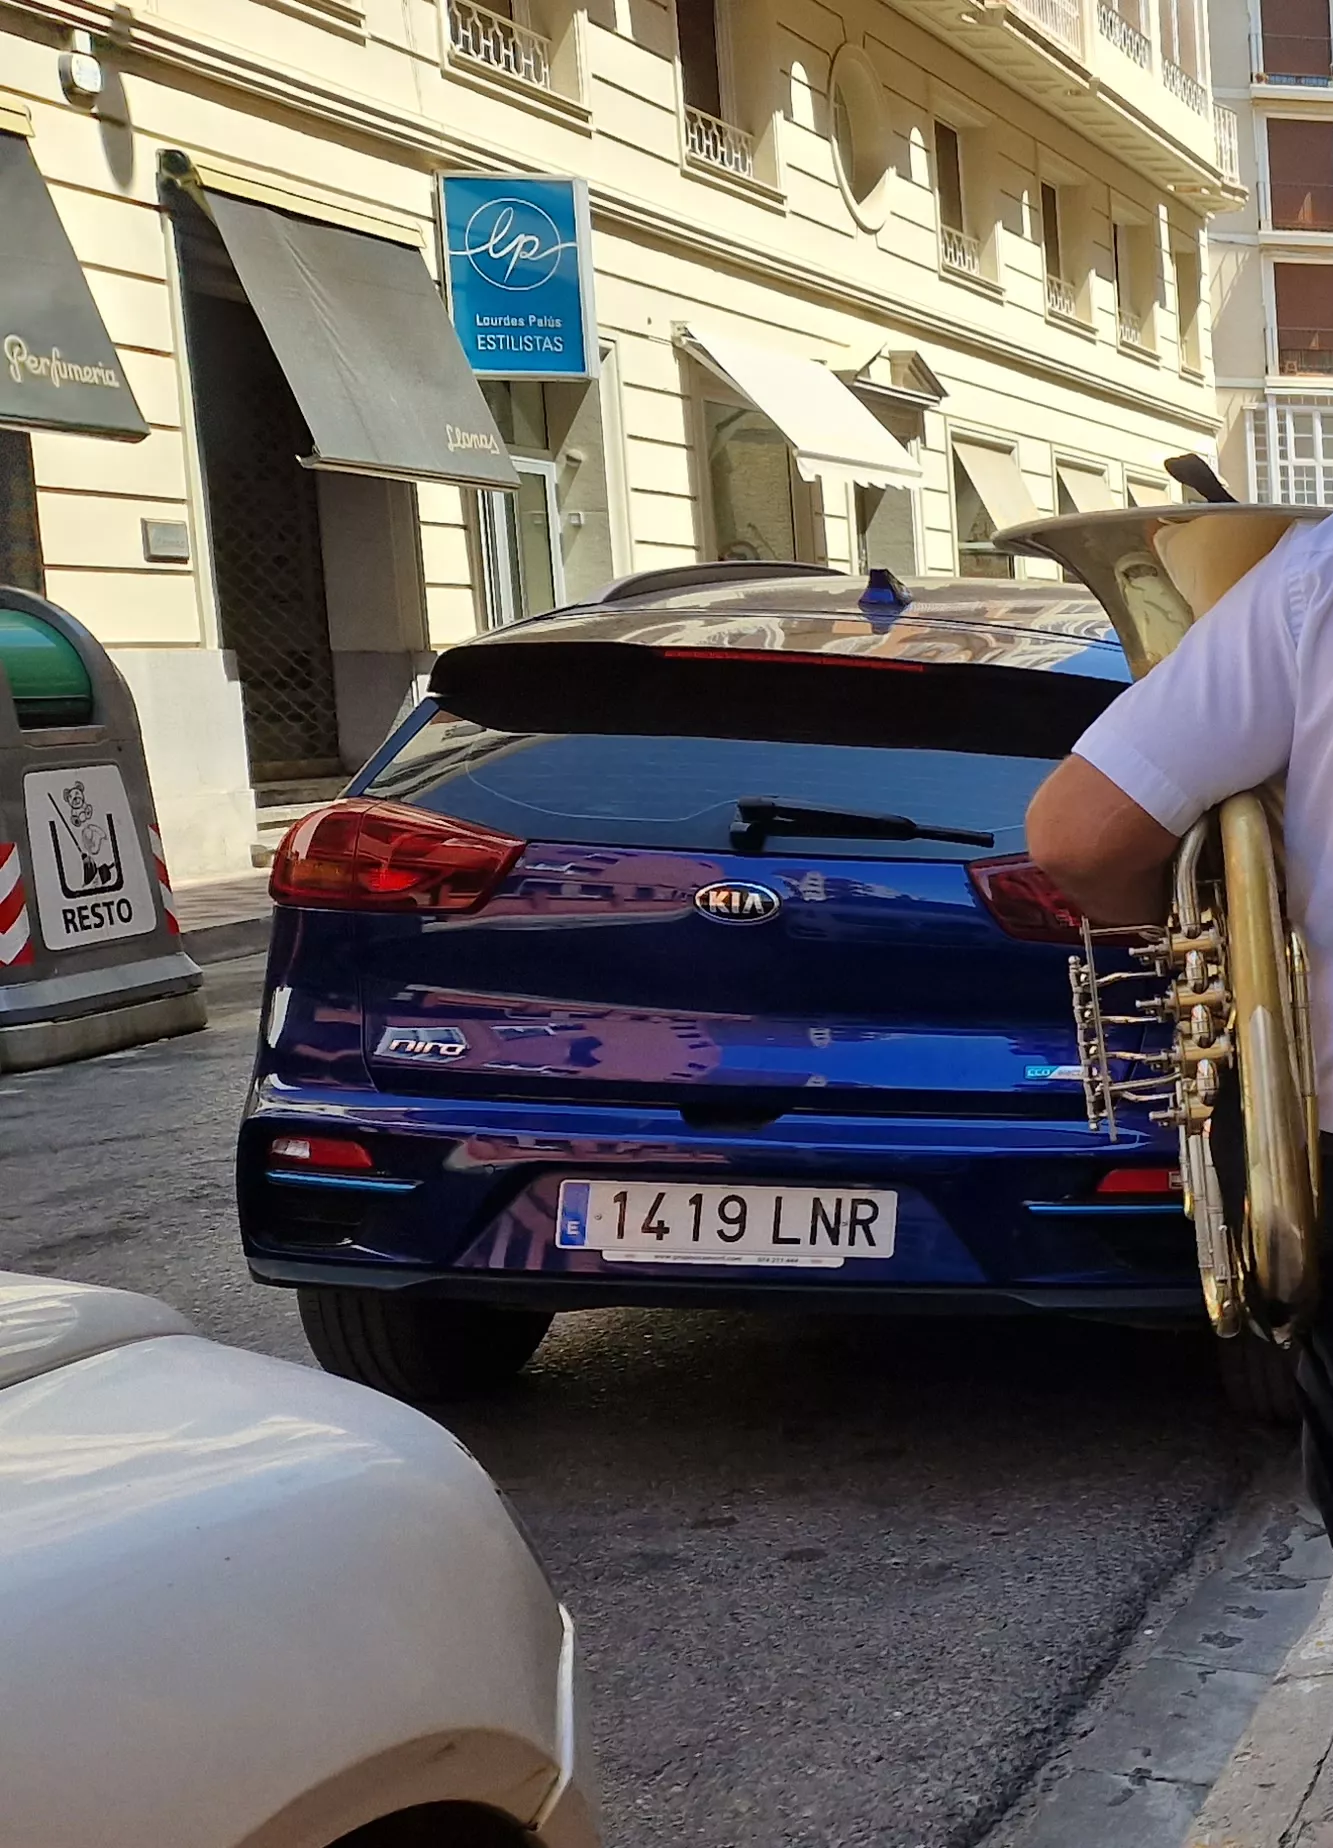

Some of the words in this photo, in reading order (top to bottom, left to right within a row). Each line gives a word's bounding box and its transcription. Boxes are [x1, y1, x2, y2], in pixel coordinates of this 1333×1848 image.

[475, 313, 526, 328] Lourdes
[528, 314, 563, 329] Palús
[476, 334, 564, 353] ESTILISTAS
[445, 423, 501, 455] Llanas
[708, 890, 765, 914] KIA
[61, 897, 133, 935] RESTO
[566, 1220, 581, 1237] E
[612, 1191, 748, 1244] 1419
[771, 1196, 880, 1248] LNR
